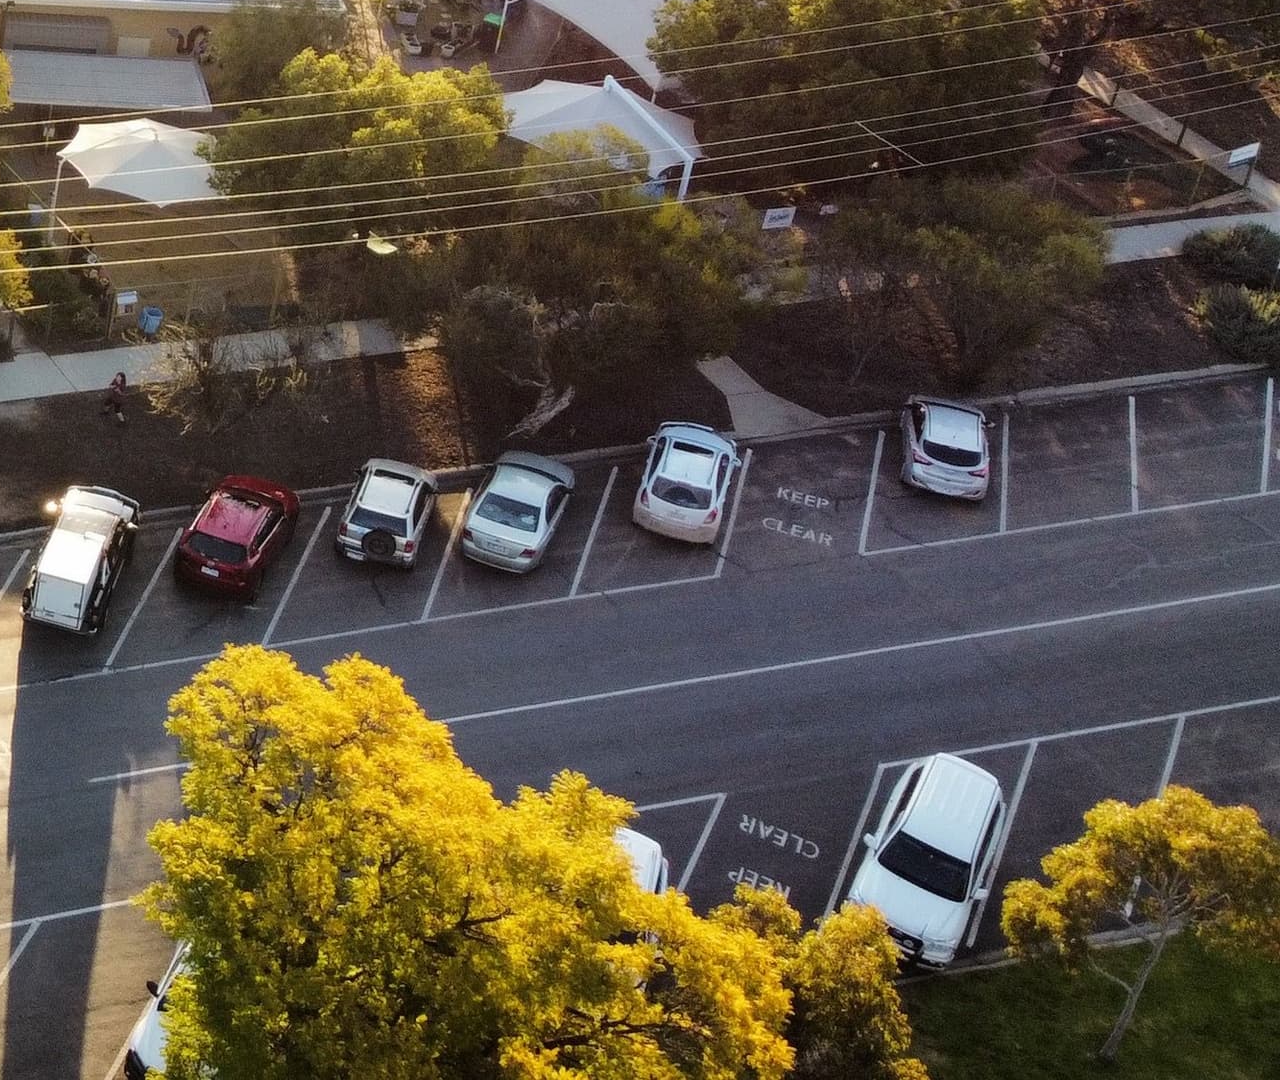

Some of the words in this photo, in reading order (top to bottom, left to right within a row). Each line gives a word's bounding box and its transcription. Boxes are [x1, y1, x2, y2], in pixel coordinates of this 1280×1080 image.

[777, 486, 830, 509] KEEP
[762, 517, 833, 546] CLEAR
[739, 813, 820, 858] CLEAR
